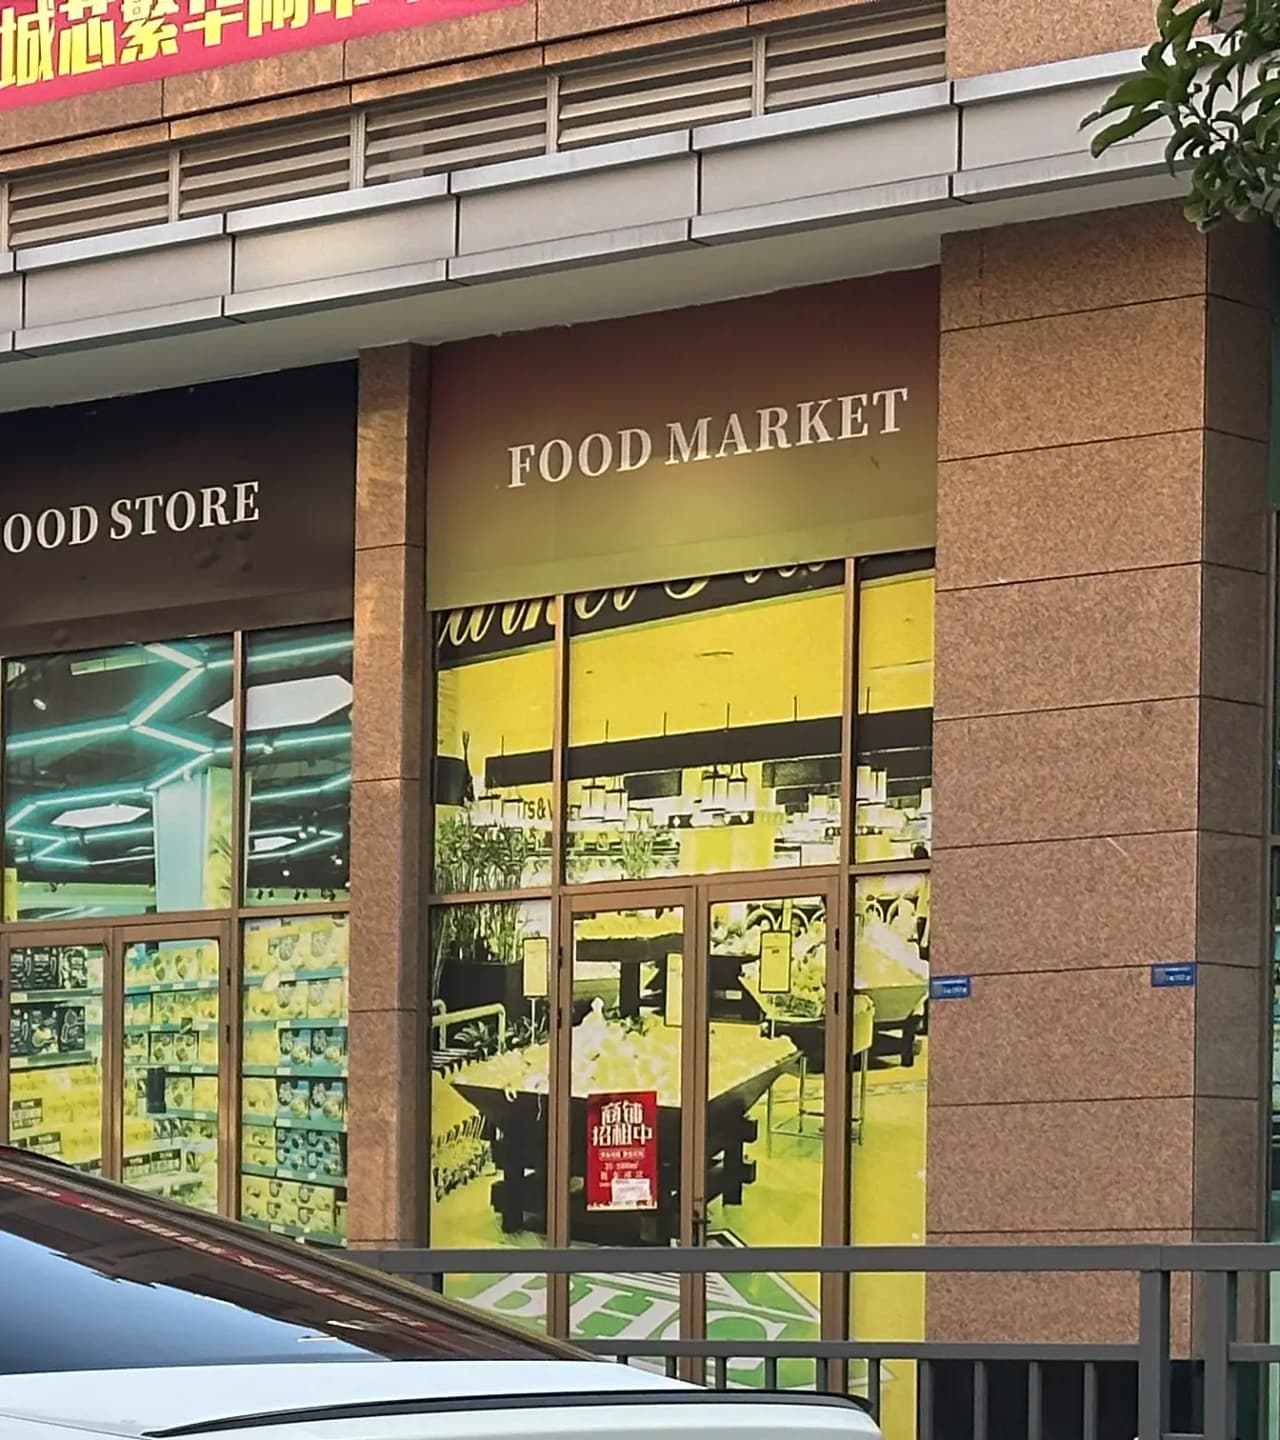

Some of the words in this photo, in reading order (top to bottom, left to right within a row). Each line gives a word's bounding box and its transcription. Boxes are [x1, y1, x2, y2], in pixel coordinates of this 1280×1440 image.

[507, 428, 652, 488] FOOD
[665, 387, 908, 465] MARKET
[110, 481, 260, 540] STORE
[592, 1123, 653, 1146] 招租中
